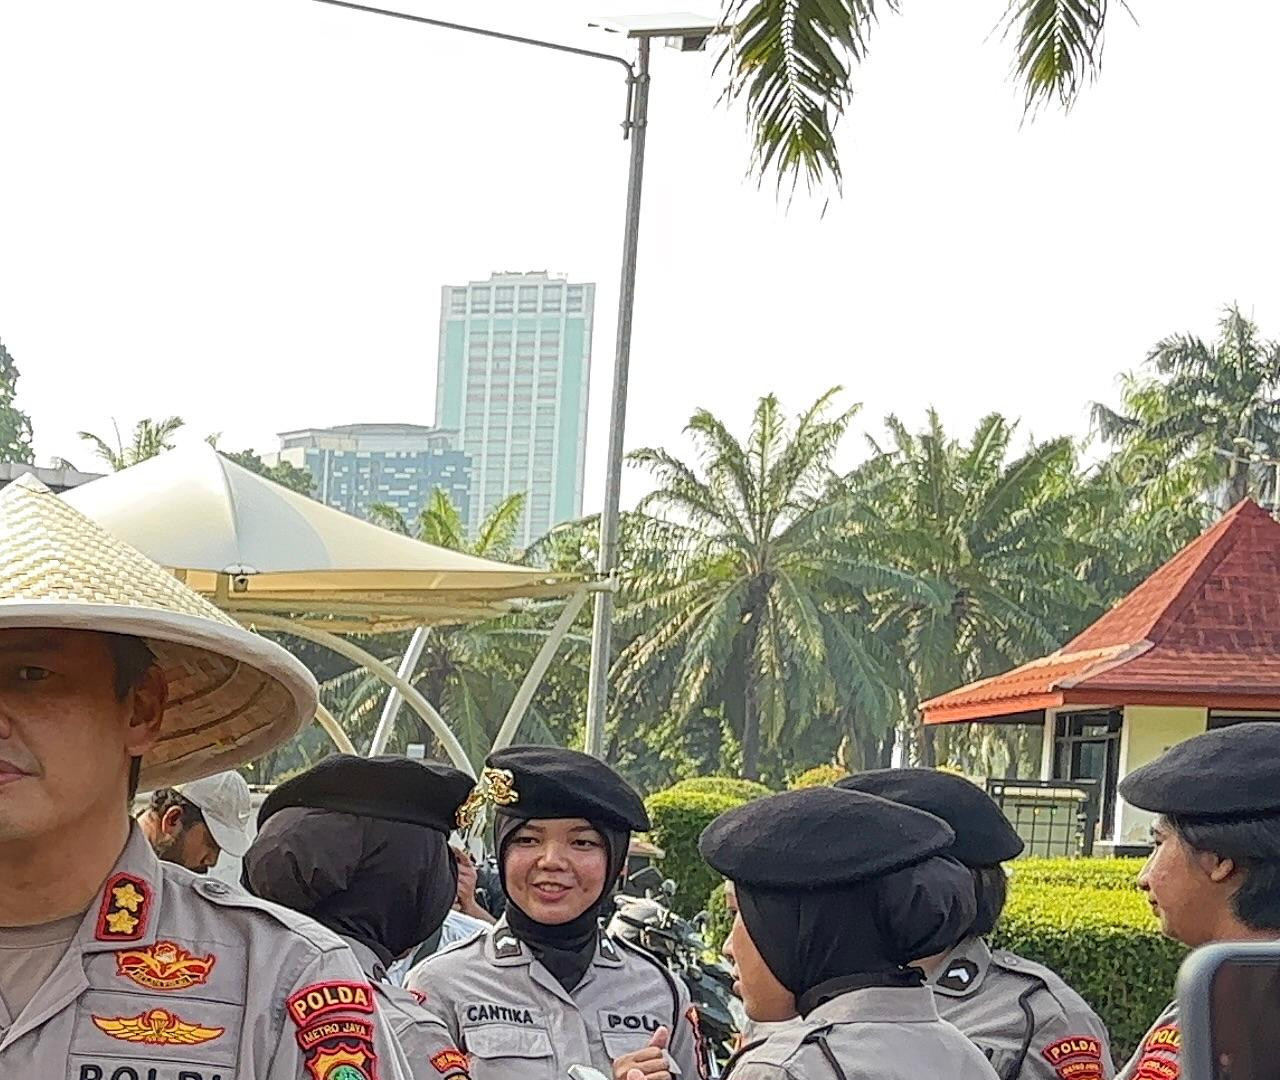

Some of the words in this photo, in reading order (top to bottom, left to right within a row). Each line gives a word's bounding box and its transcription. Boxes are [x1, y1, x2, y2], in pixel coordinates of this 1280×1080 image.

[293, 983, 369, 1018] POLDA
[466, 1004, 534, 1025] CANTIKA
[608, 1014, 661, 1032] POL
[303, 1022, 340, 1044] METRO
[342, 1022, 367, 1036] JAYA
[1050, 1040, 1098, 1059] POLDA
